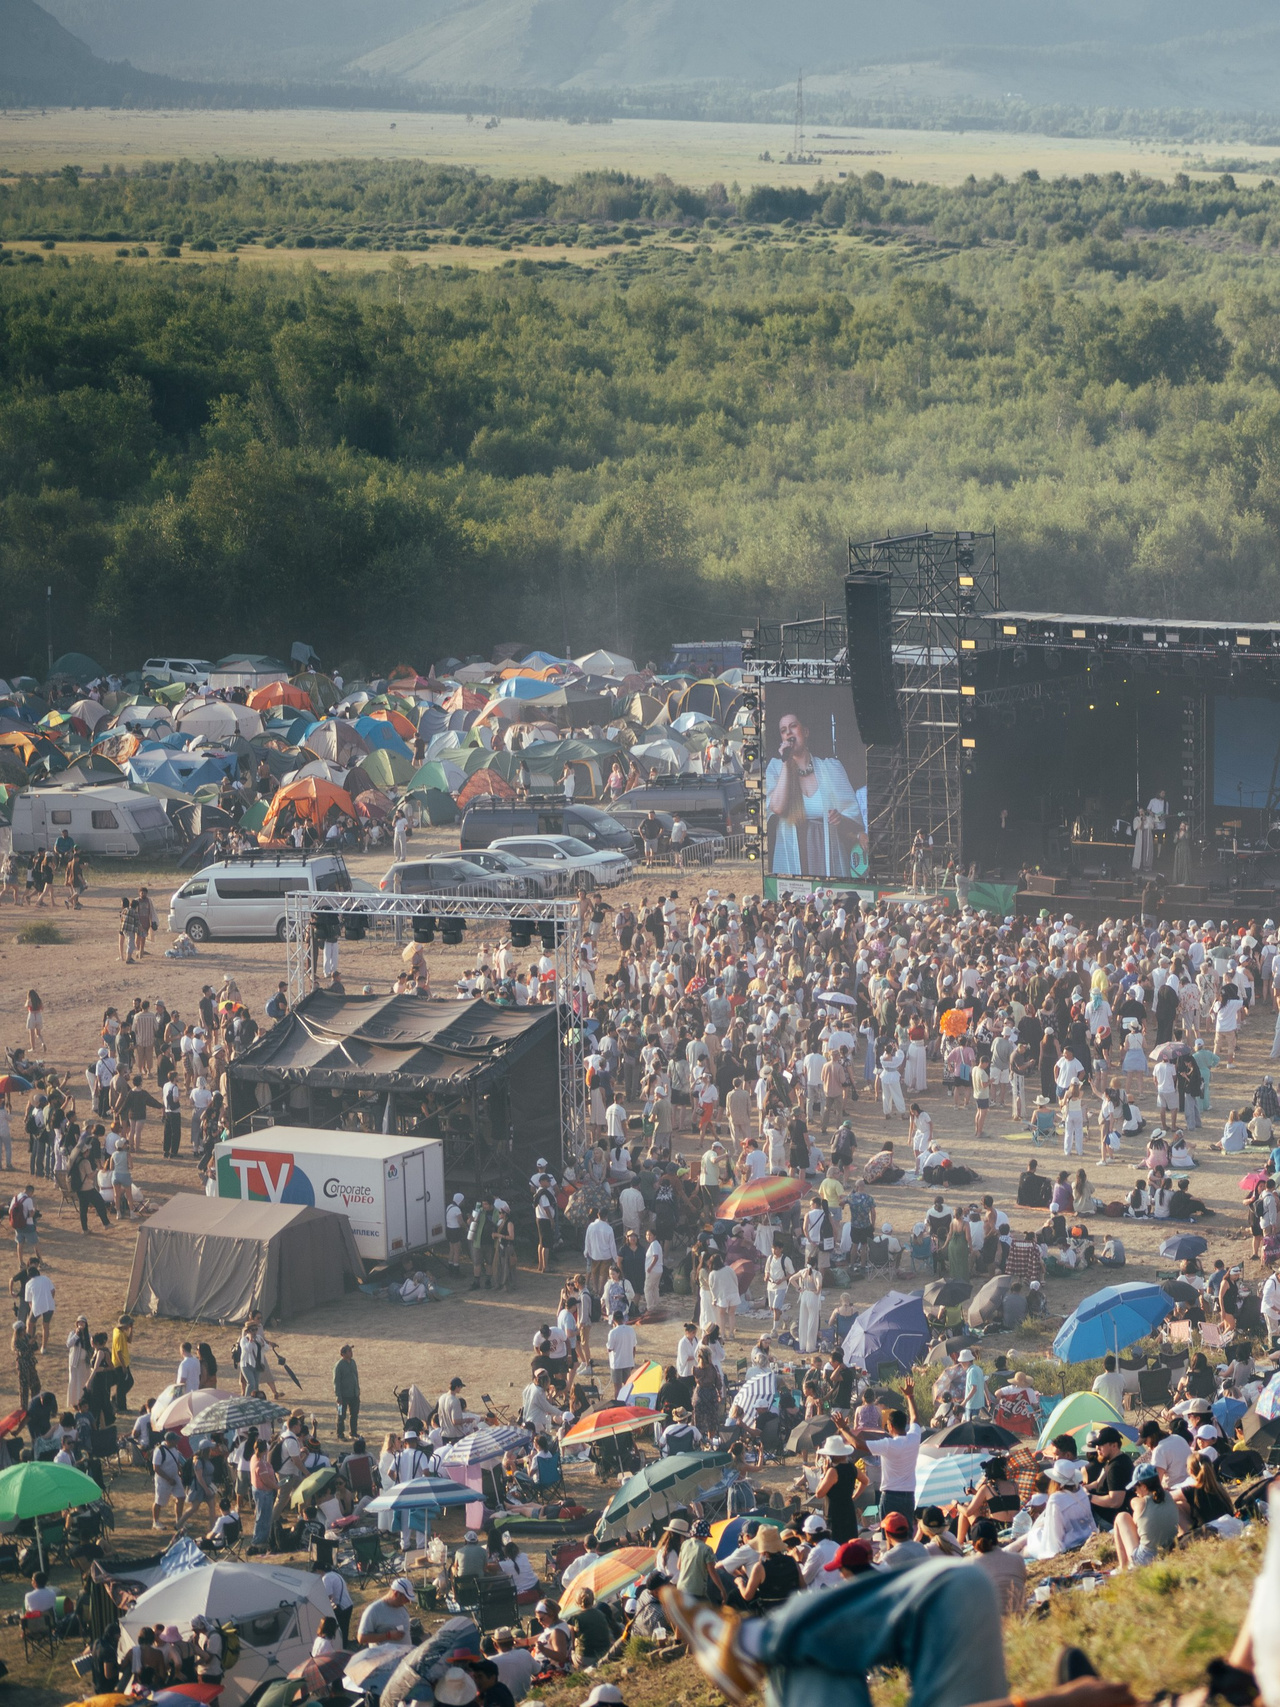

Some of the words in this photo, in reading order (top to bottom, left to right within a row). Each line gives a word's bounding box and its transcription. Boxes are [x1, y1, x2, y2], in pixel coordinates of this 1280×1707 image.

[229, 1158, 290, 1204] TV
[323, 1178, 371, 1198] Corporate
[342, 1194, 375, 1208] VIDEO
